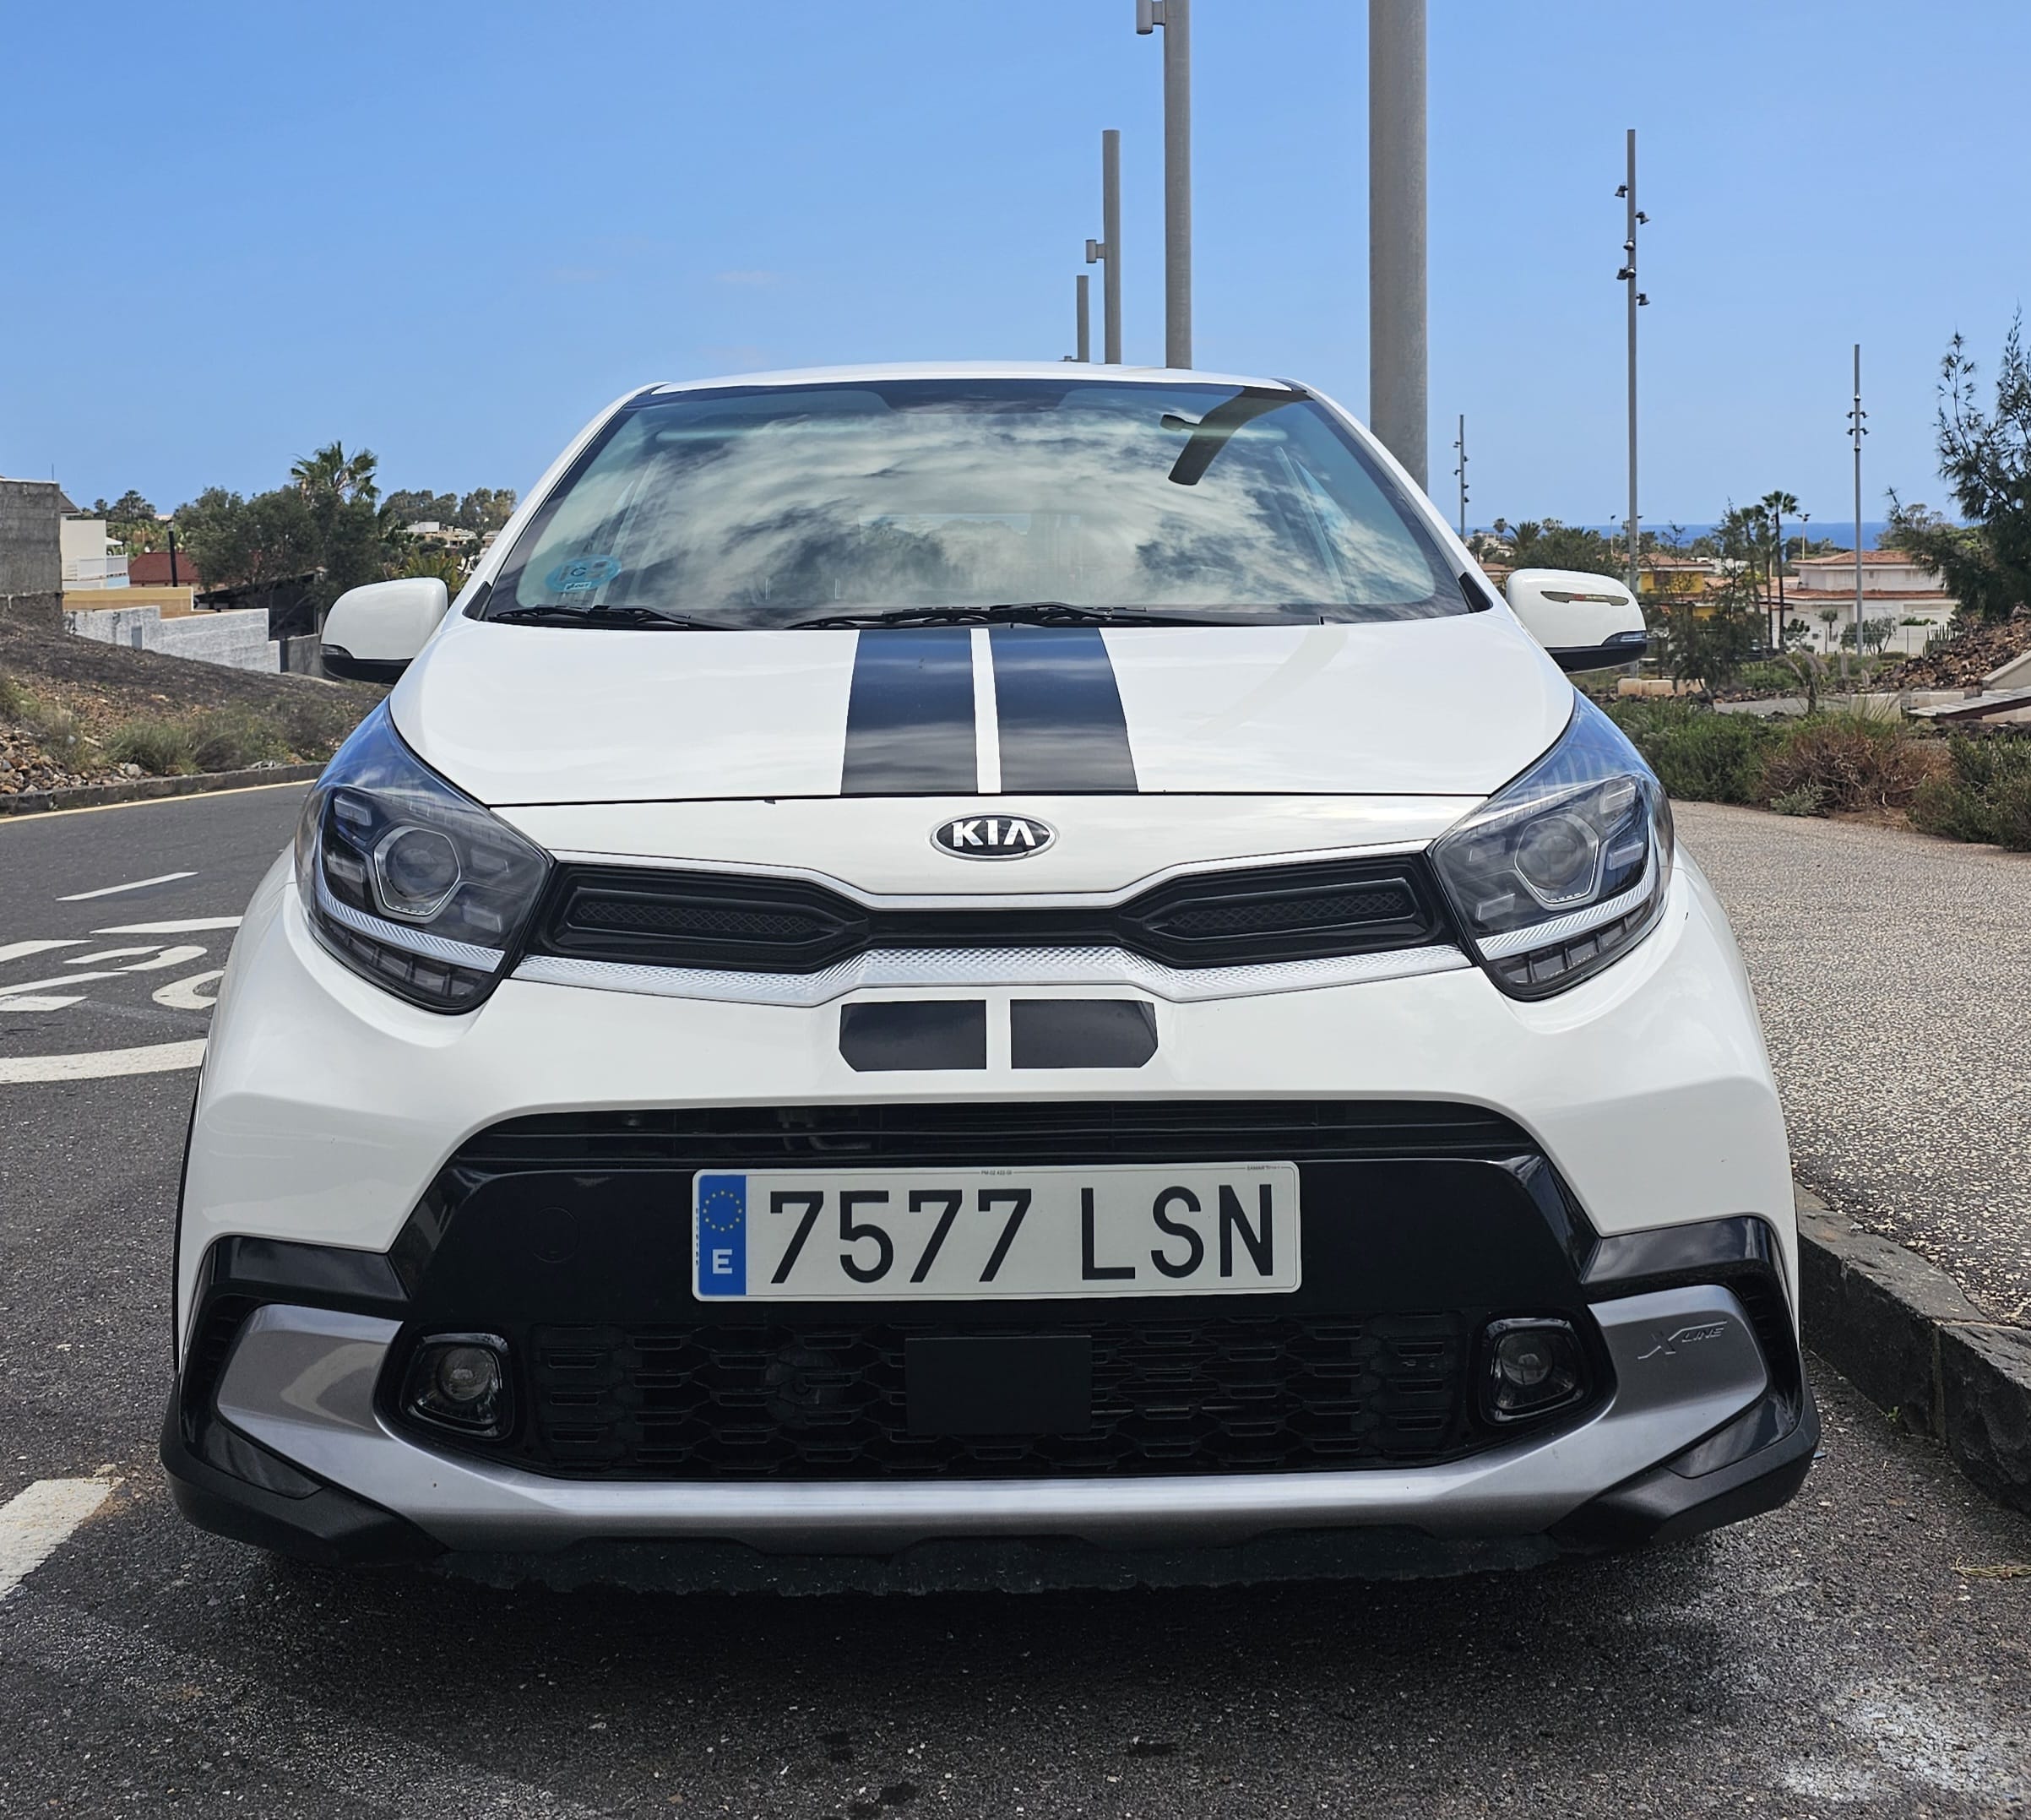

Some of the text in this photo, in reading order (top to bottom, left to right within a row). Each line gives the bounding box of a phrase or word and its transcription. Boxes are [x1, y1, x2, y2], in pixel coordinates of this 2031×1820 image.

[952, 819, 1036, 847] KIA
[770, 1189, 1032, 1284] 7577
[1081, 1184, 1273, 1280] LSN
[712, 1249, 732, 1274] E
